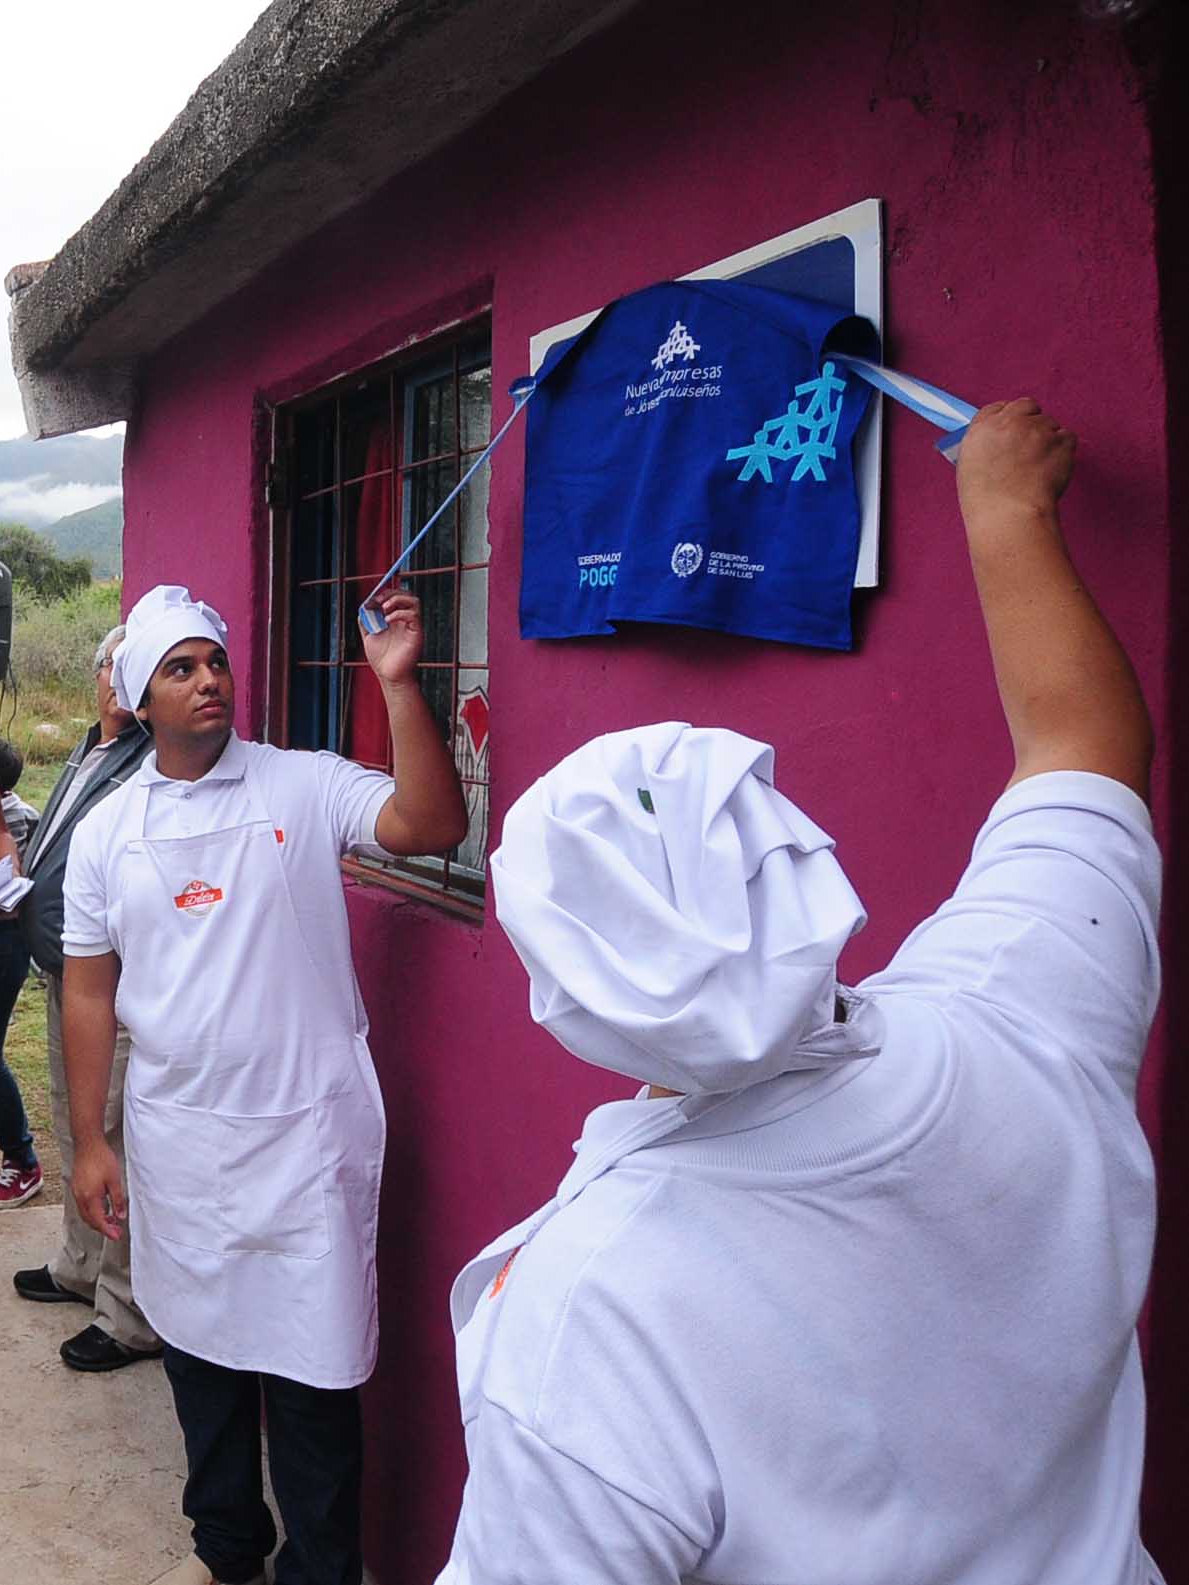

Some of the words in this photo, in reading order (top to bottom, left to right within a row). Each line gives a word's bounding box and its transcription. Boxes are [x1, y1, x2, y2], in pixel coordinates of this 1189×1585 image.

[625, 378, 661, 400] Nueva
[661, 365, 723, 384] mpresas
[579, 565, 618, 589] POGG
[719, 567, 736, 577] SAN
